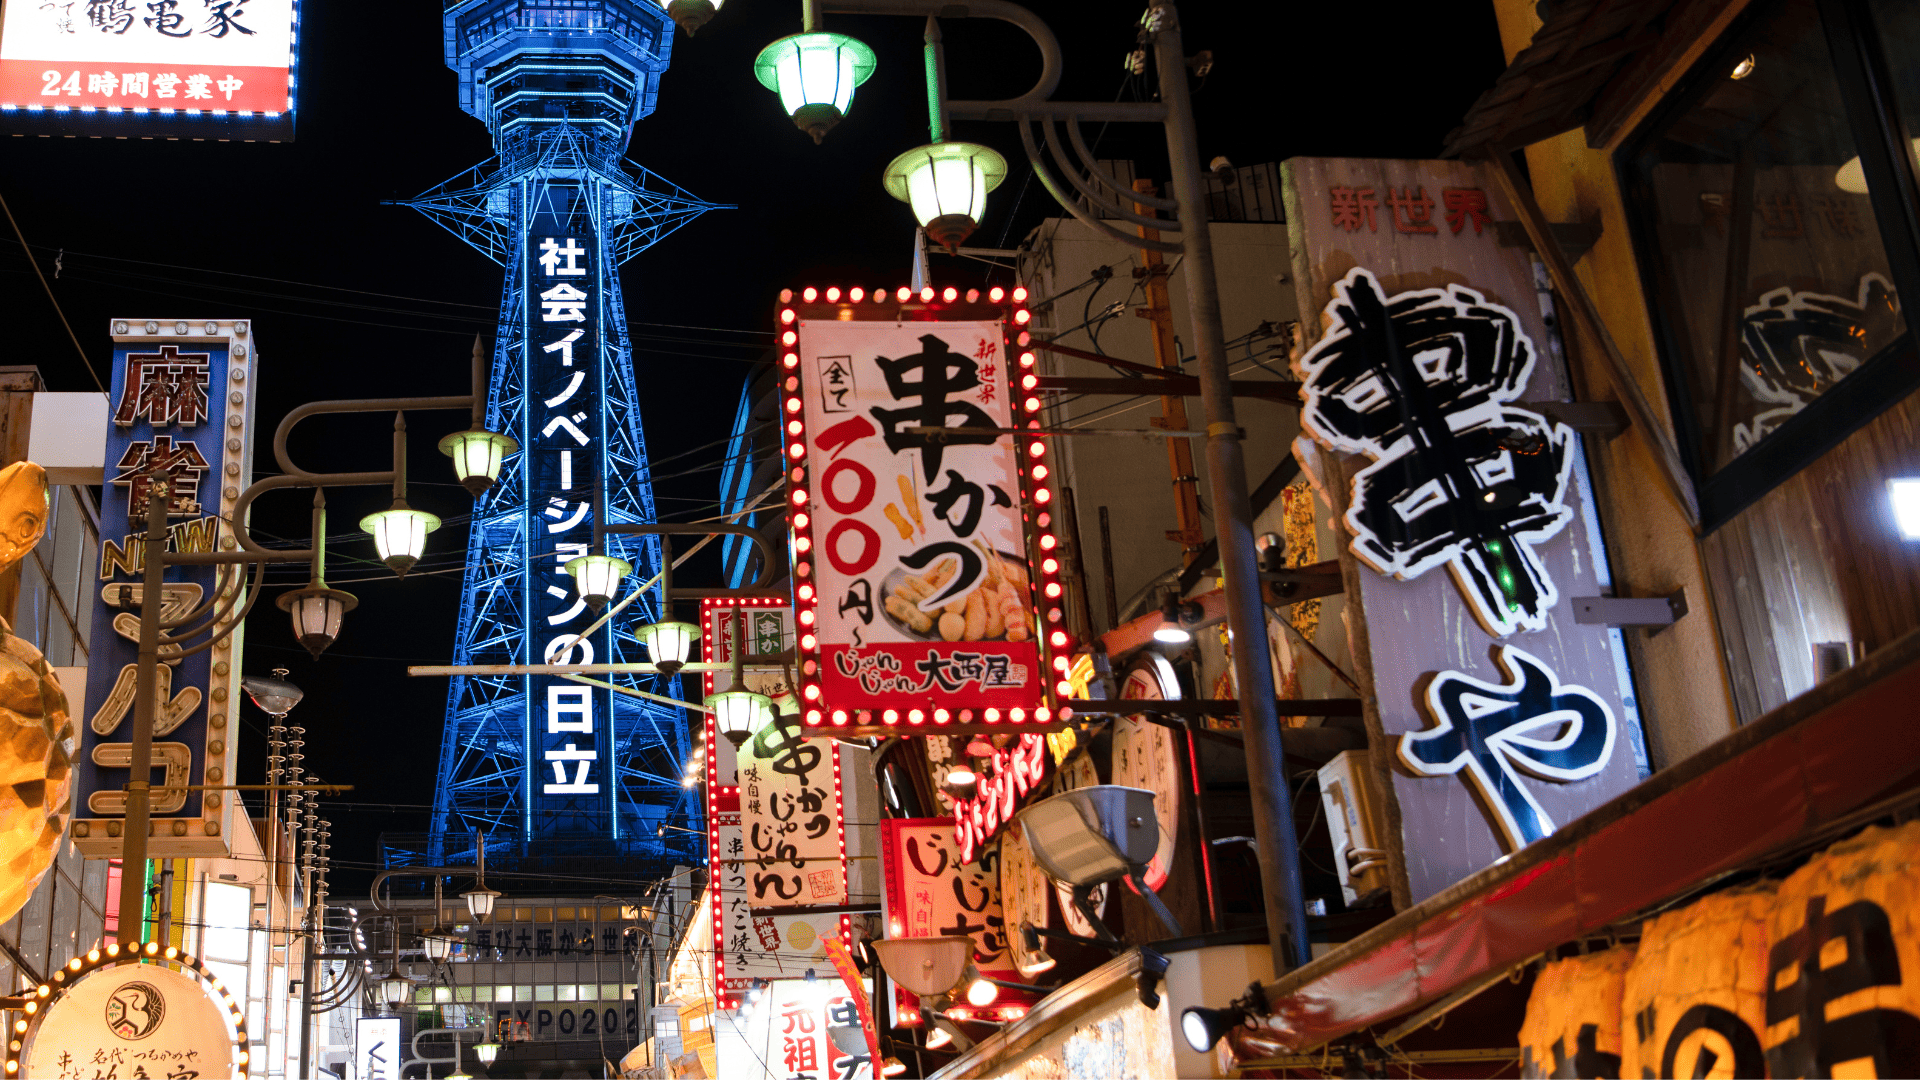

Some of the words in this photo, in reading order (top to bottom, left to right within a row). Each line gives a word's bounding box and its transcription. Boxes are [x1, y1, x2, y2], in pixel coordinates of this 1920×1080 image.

[40, 70, 244, 101] 24時間営業中
[1331, 186, 1492, 234] 新世界
[821, 360, 851, 408] 全て
[973, 338, 999, 405] 新世界
[108, 345, 211, 518] 麻雀
[868, 333, 1012, 608] 串かつ
[538, 237, 600, 794] 社会イノベーションの日立
[915, 649, 1026, 694] 大西屋
[744, 763, 763, 816] 味自慢
[729, 897, 752, 972] たこ焼き
